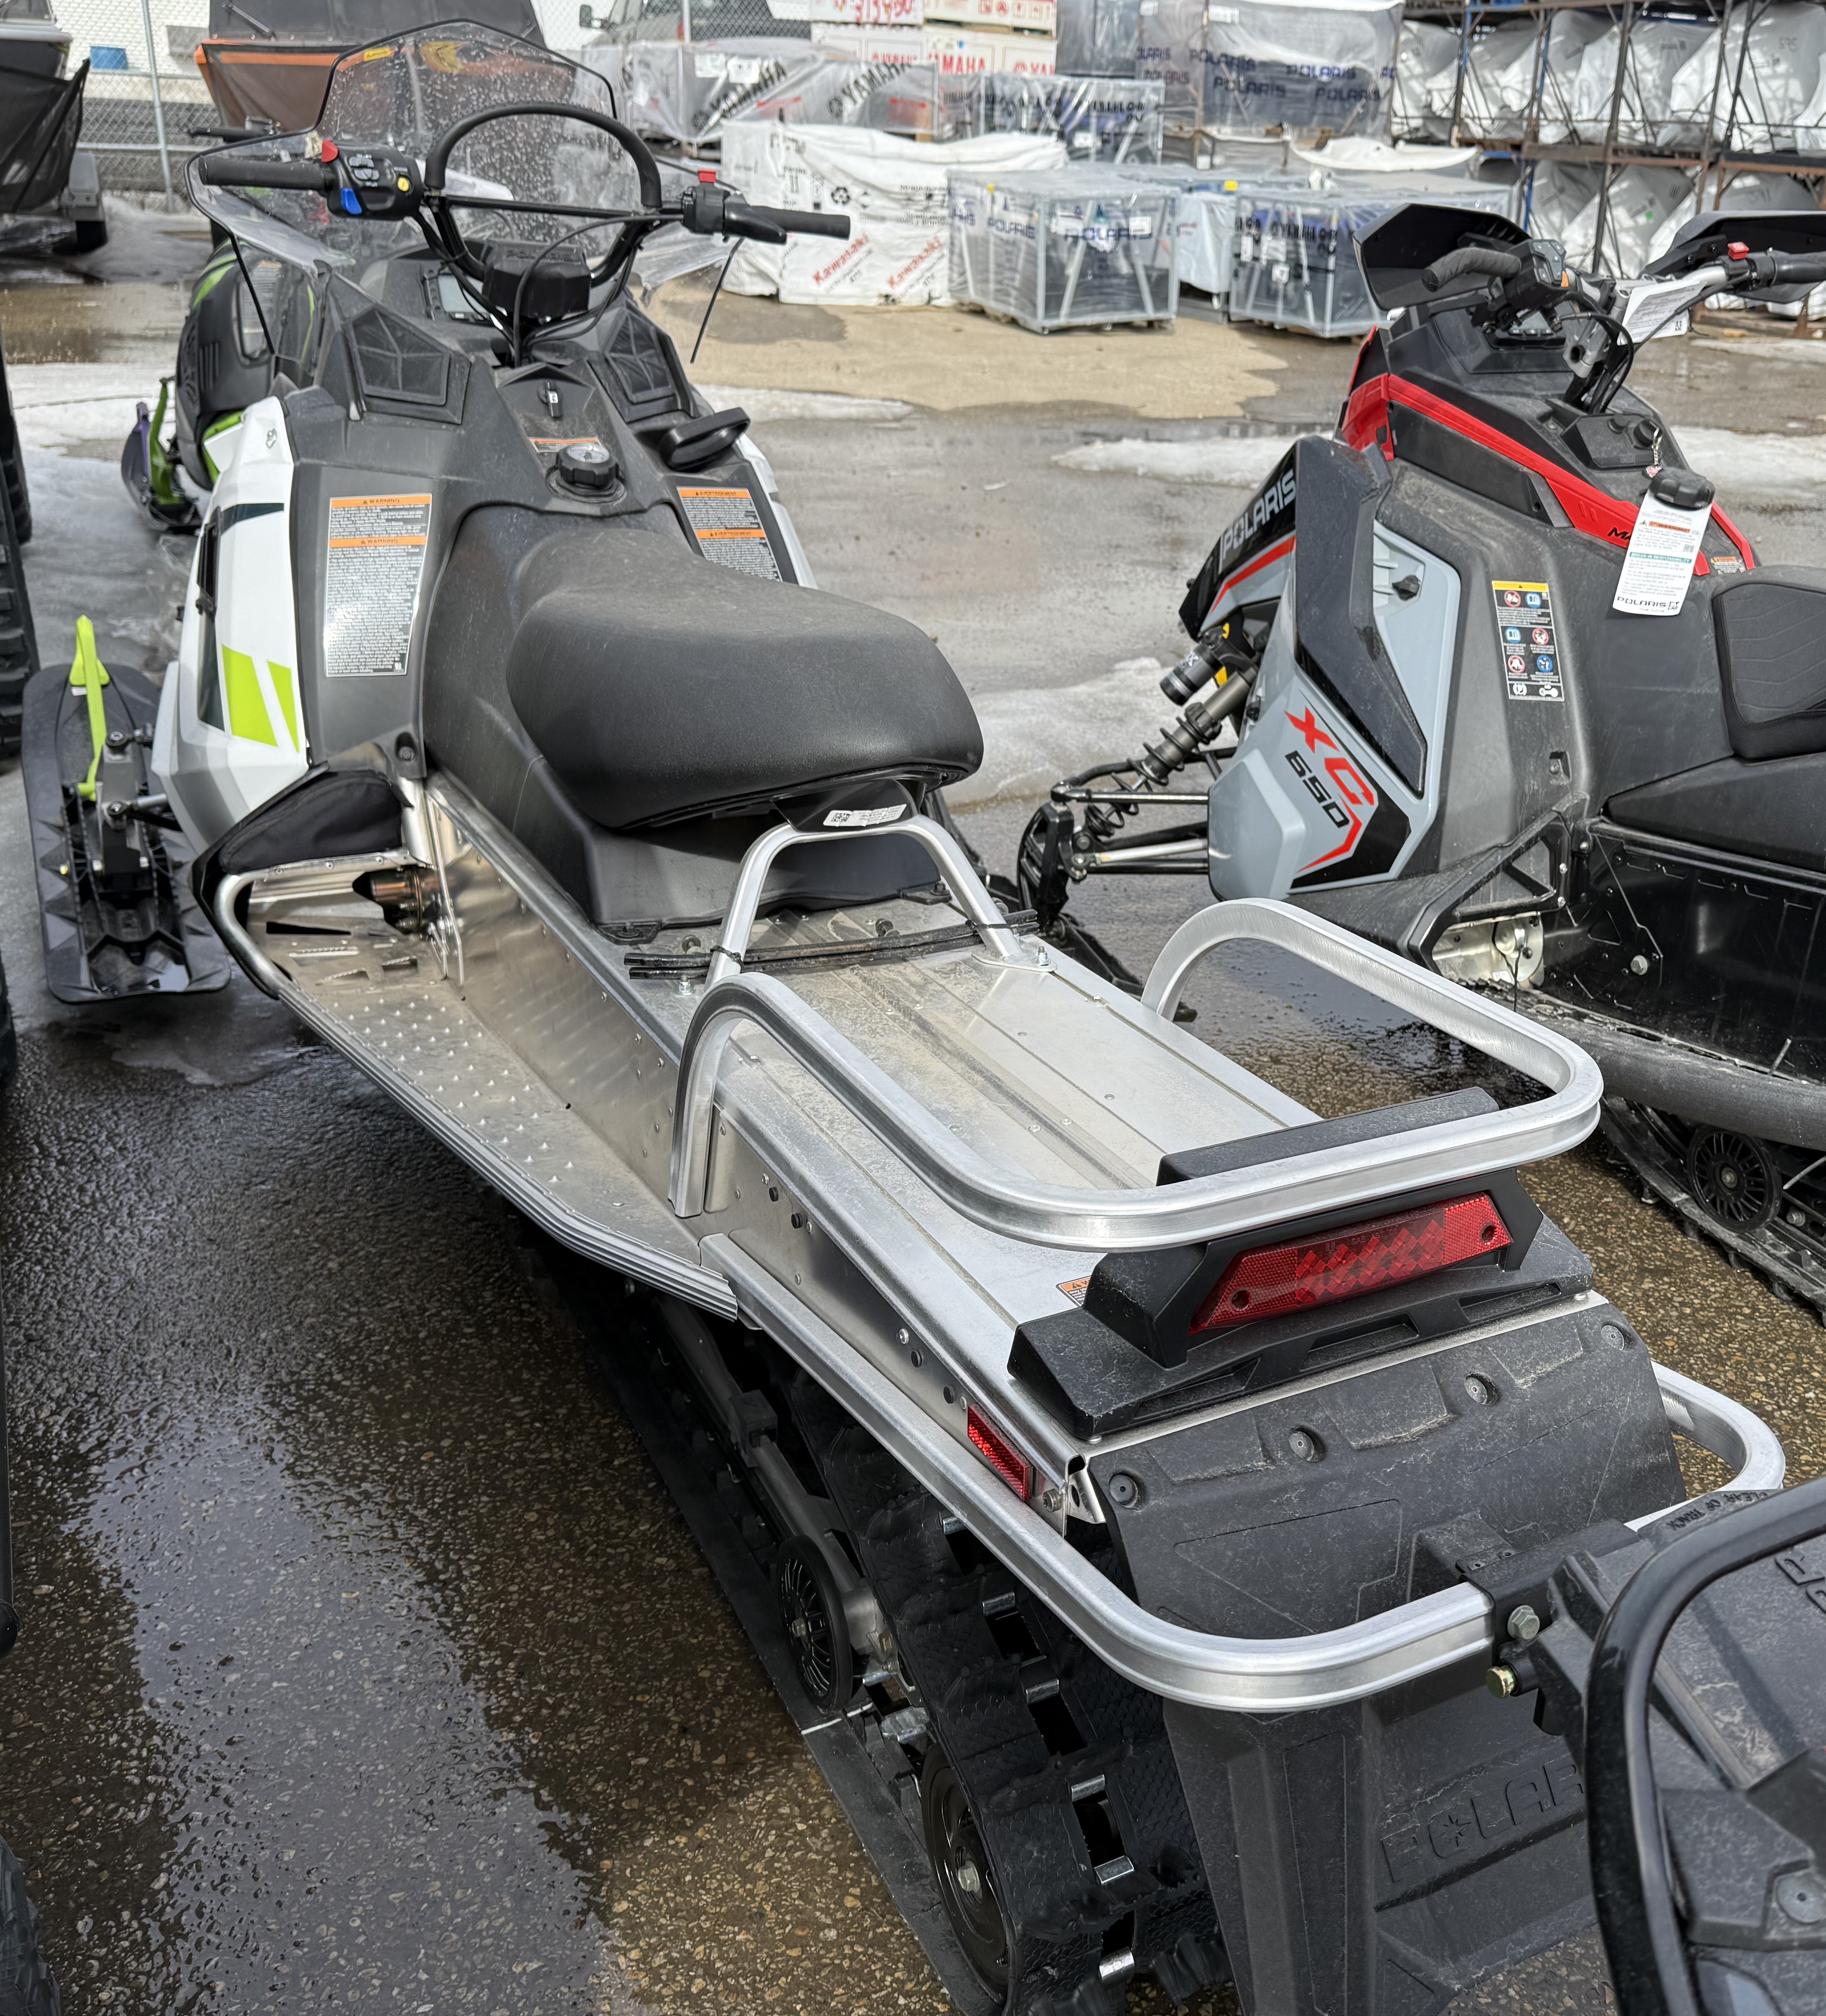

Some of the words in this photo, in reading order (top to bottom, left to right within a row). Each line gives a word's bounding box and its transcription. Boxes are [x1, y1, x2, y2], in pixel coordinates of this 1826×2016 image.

[1213, 76, 1286, 98] POLARIS
[1315, 86, 1381, 102] POLARIS
[812, 233, 870, 286] Kawasaki
[887, 236, 945, 288] Kawasaki
[1223, 469, 1297, 560] POLARIS
[1617, 596, 1666, 607] POLARIS
[1285, 706, 1375, 806] XC
[1285, 750, 1350, 829] 650
